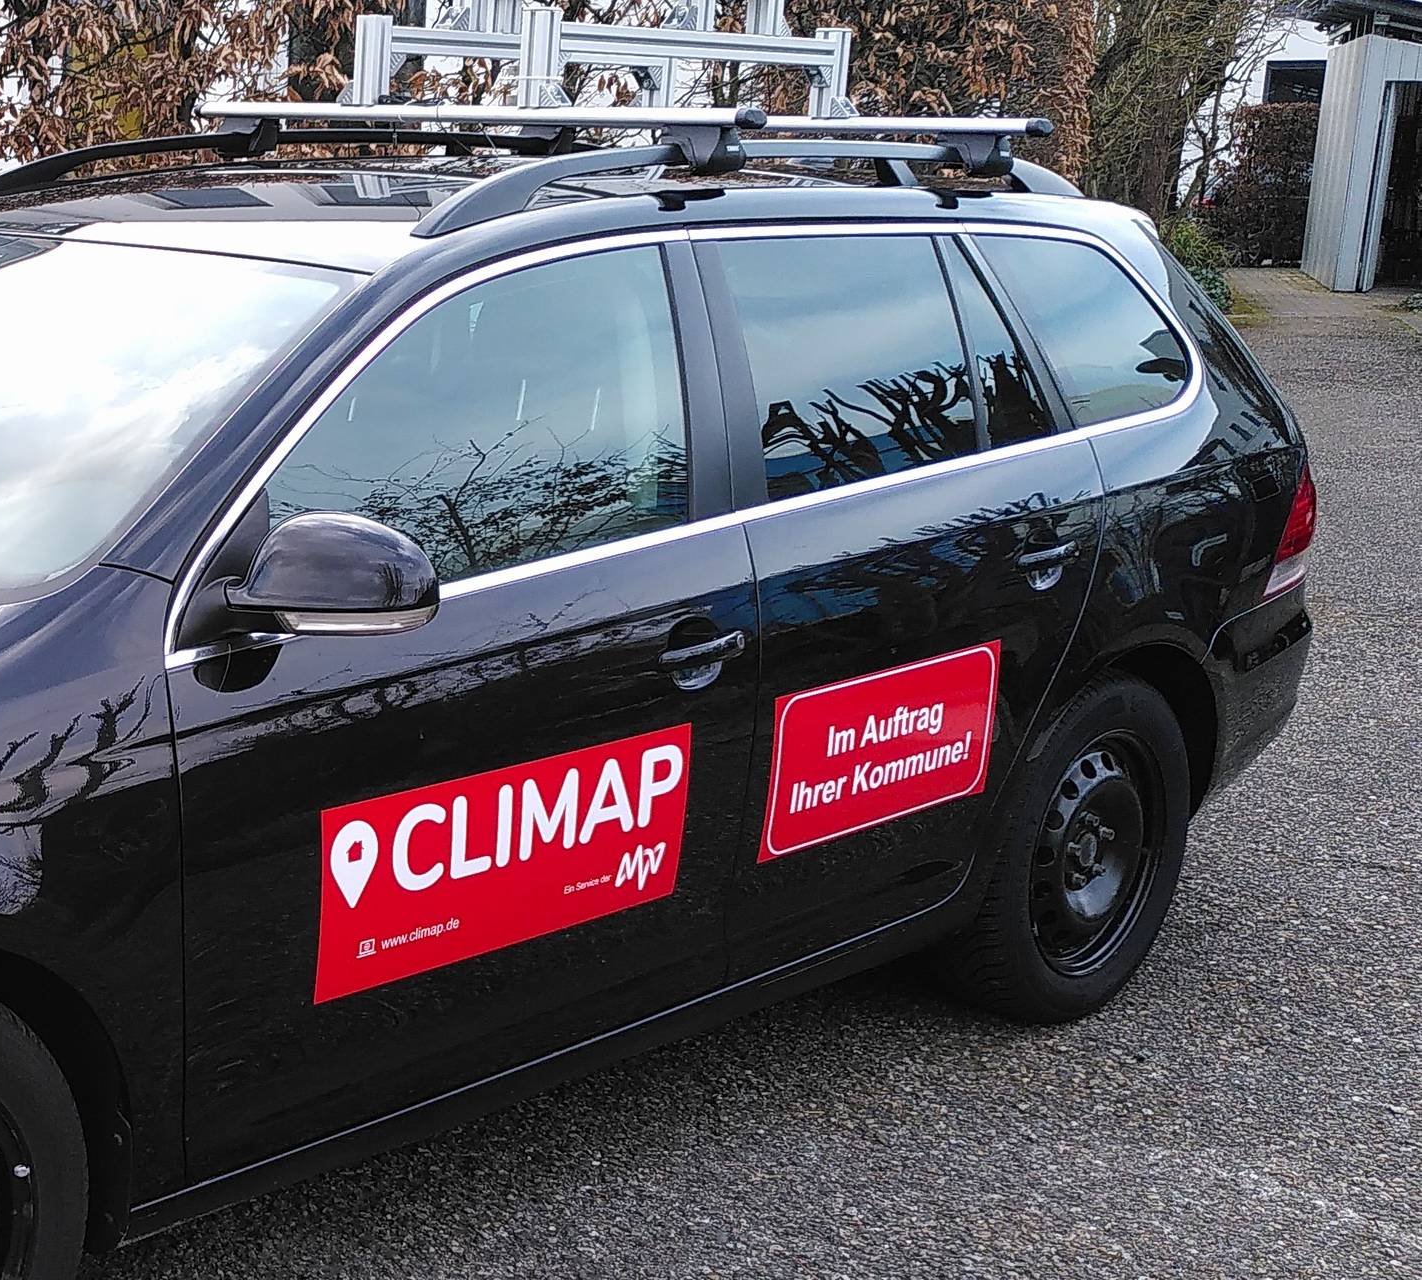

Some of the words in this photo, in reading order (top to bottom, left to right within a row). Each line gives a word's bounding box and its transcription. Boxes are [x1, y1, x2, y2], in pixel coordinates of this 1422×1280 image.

[827, 726, 855, 757] Im
[860, 703, 944, 748] Auftrag
[790, 781, 847, 814] Ihrer
[852, 732, 971, 795] Kommune!
[392, 744, 683, 891] CLIMAP
[564, 885, 575, 895] Ein
[575, 878, 599, 891] Service
[599, 874, 612, 884] der
[381, 918, 459, 949] www.climap.de
